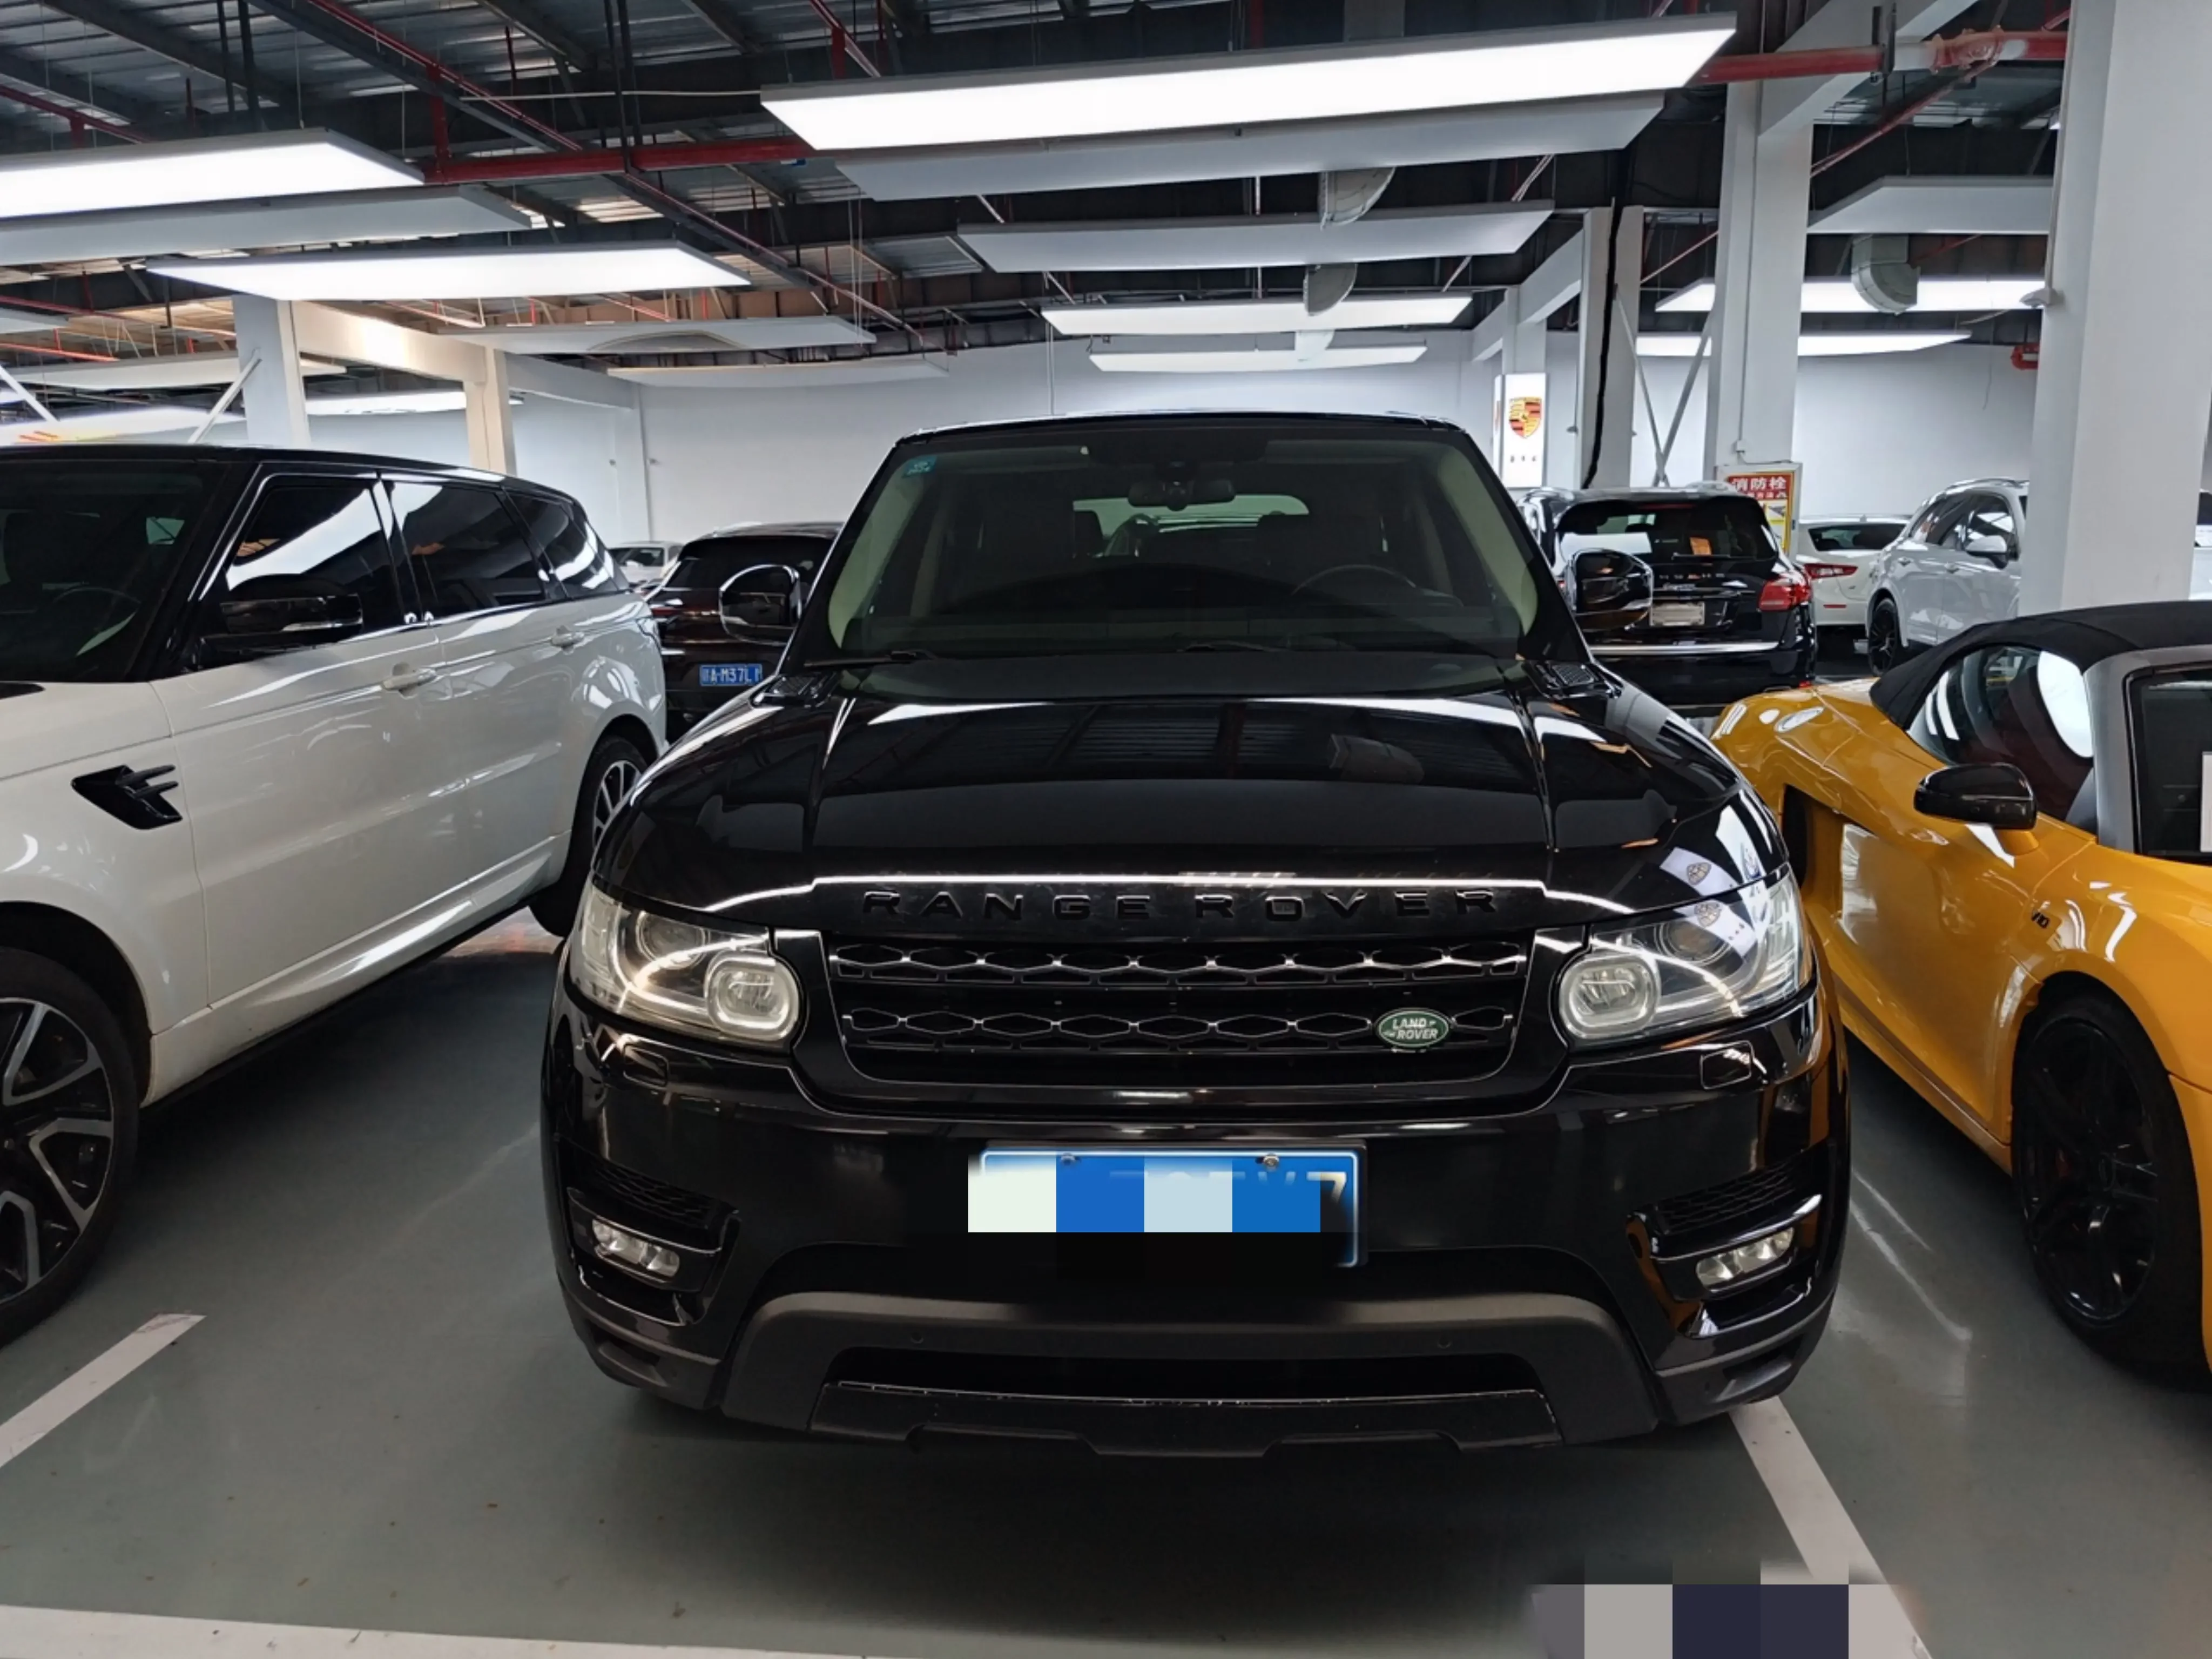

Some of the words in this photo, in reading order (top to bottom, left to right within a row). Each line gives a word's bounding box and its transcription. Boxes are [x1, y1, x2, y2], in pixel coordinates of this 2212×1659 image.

[1731, 476, 1786, 491] 消防栓
[864, 891, 1151, 919] RANGE
[1194, 890, 1498, 921] ROVER
[1392, 1017, 1427, 1029] LAND
[1396, 1028, 1438, 1040] ROVER
